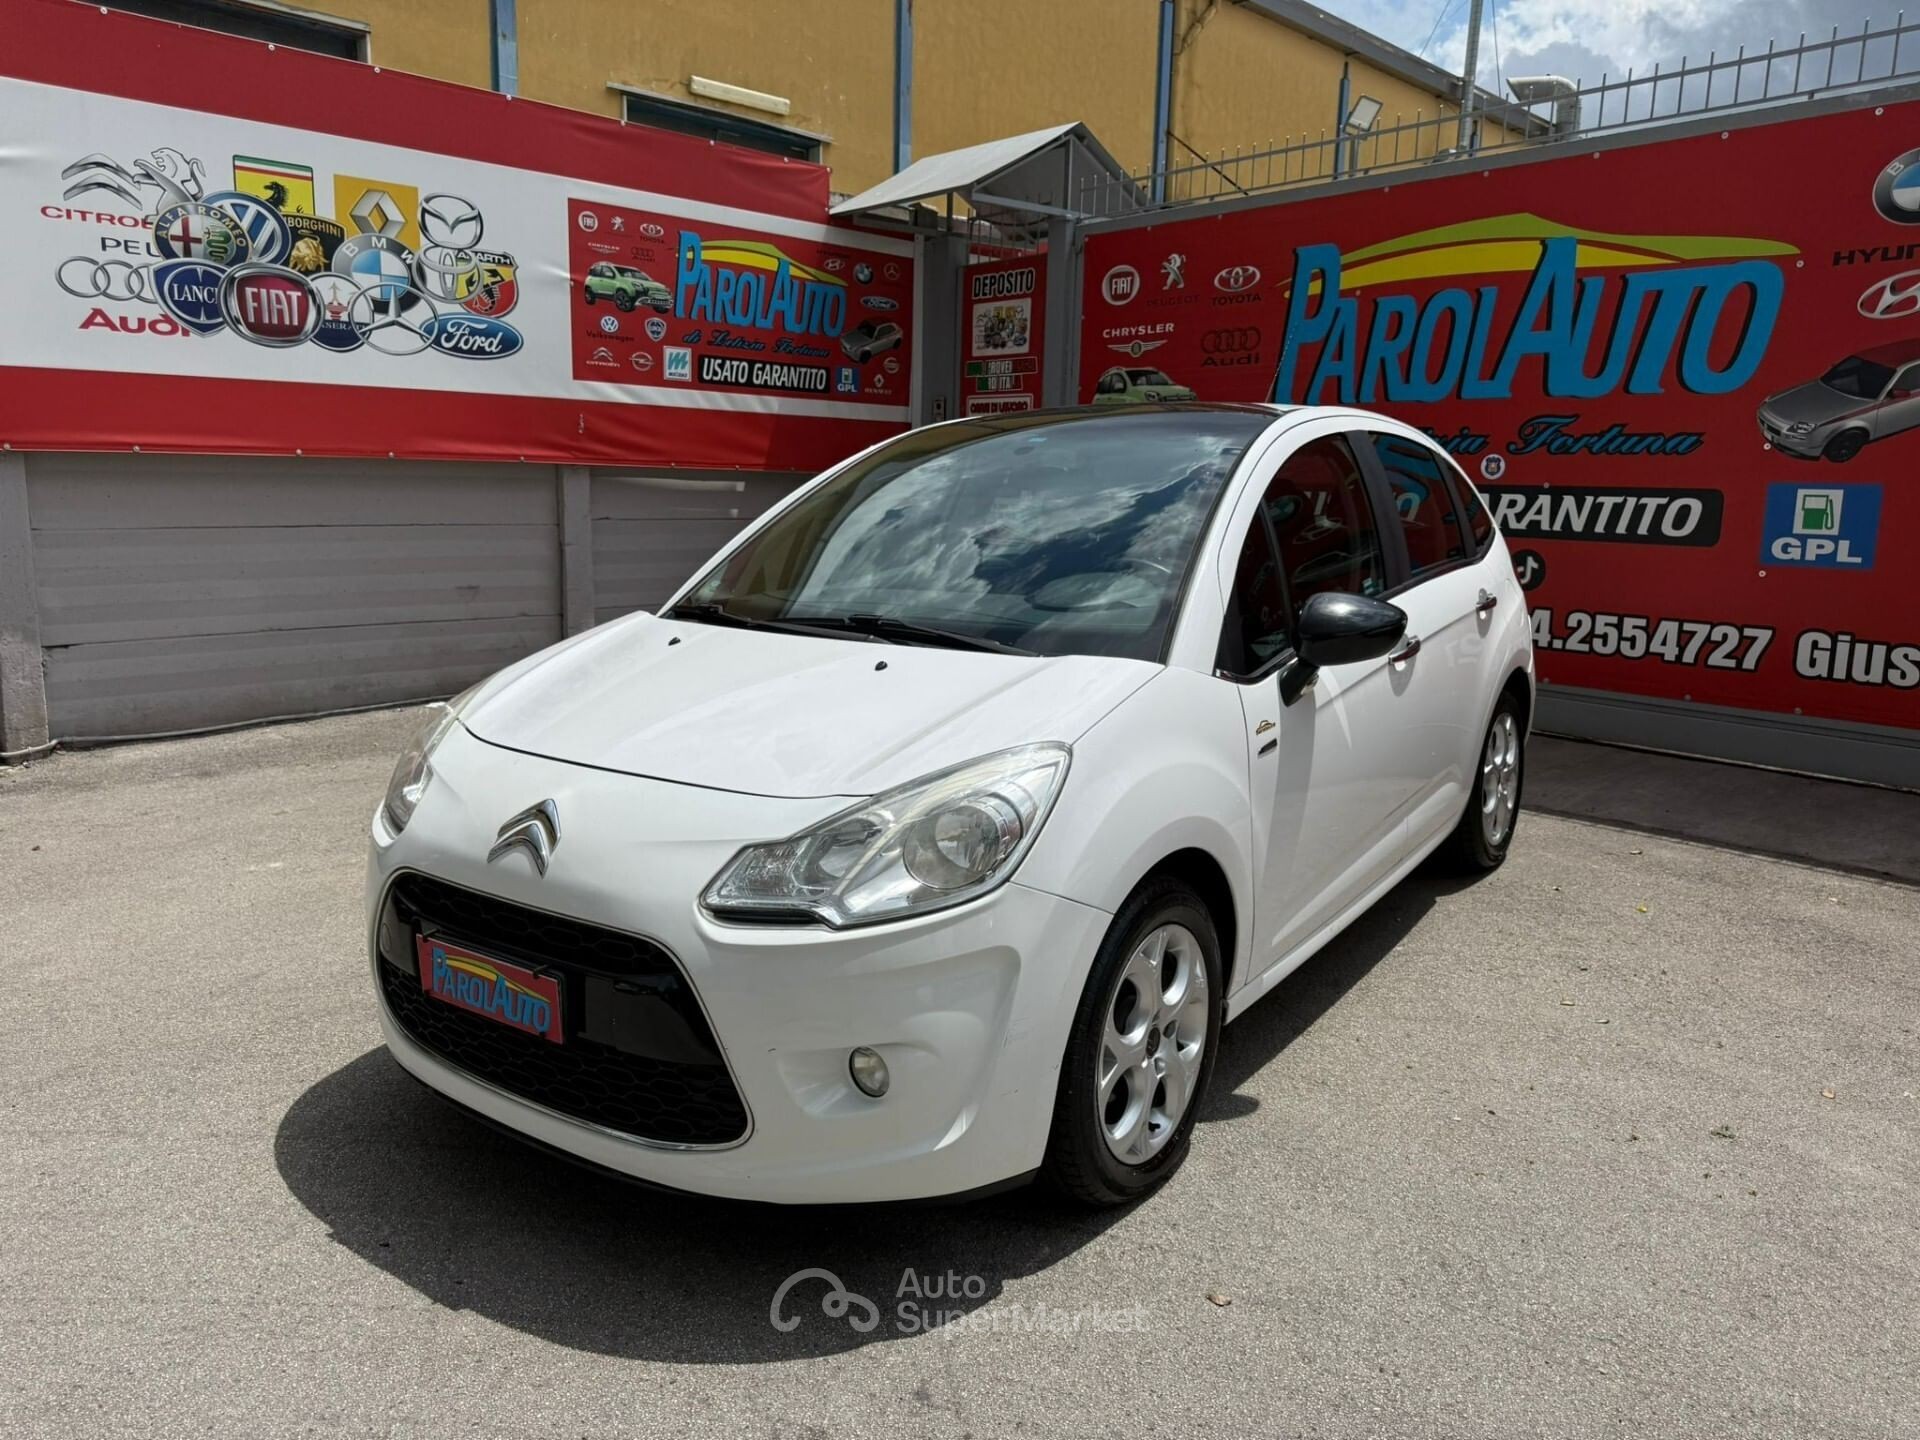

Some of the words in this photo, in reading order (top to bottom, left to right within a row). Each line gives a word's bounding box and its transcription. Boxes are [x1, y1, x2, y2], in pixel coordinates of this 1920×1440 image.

[158, 207, 185, 238] ALFA
[199, 206, 247, 248] ROMEO
[456, 250, 511, 265] AARTH
[973, 269, 1034, 298] DEPOSITO
[1112, 277, 1132, 295] FIAT
[244, 286, 303, 327] FIAT
[1147, 294, 1200, 307] PEUGEOT
[1212, 292, 1262, 306] TOYOTA
[440, 319, 504, 353] Ford
[1102, 323, 1175, 338] CHRYSLER
[702, 357, 748, 382] USATO
[753, 362, 827, 391] GARANTITO
[1202, 354, 1260, 367] Audi
[836, 383, 858, 393] GPL
[1507, 414, 1706, 456] Fortuna
[1770, 536, 1863, 564] GPL
[1795, 631, 1920, 687] Gius
